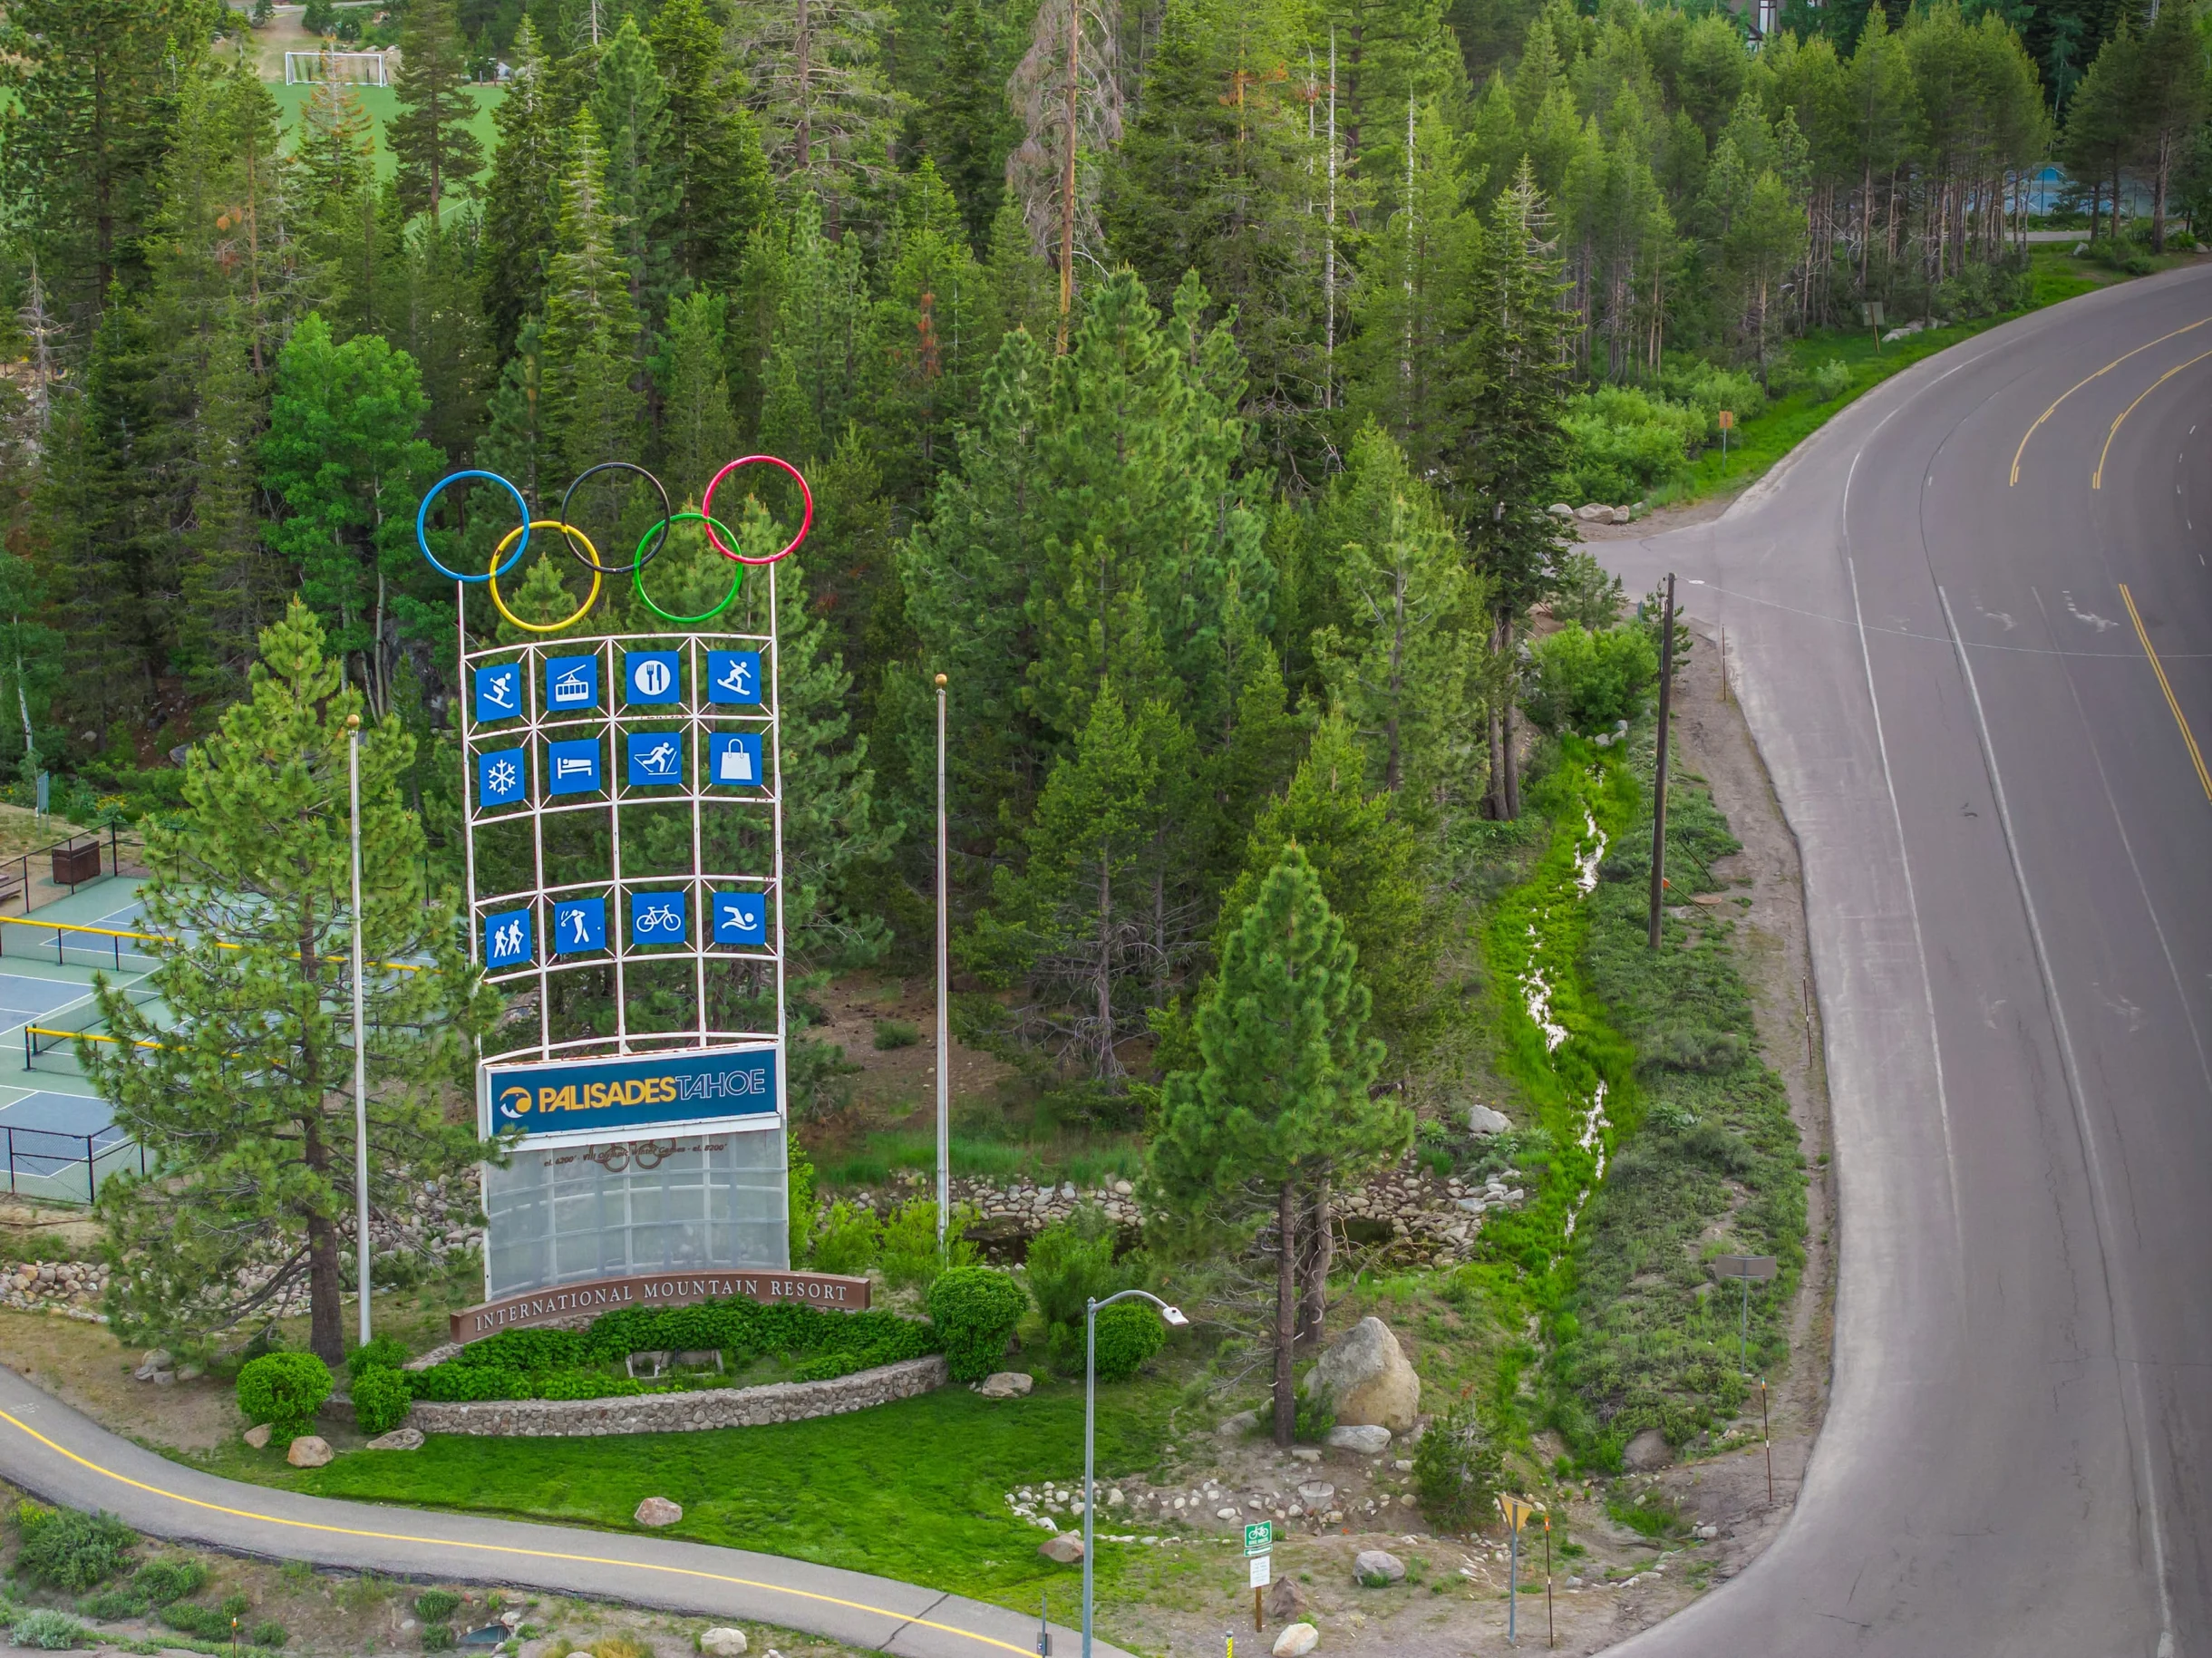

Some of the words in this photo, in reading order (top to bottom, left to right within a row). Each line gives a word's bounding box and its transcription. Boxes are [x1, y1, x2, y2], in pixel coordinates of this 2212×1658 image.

[538, 1076, 677, 1113] PALISADES
[675, 1069, 765, 1100] TAHOE
[597, 1149, 629, 1161] Olympic
[631, 1147, 656, 1156] Winter
[659, 1145, 685, 1154] Games
[476, 1285, 633, 1332] INTERNATIONAL
[644, 1279, 758, 1298] MOUNTAIN
[771, 1280, 847, 1301] RESORT
